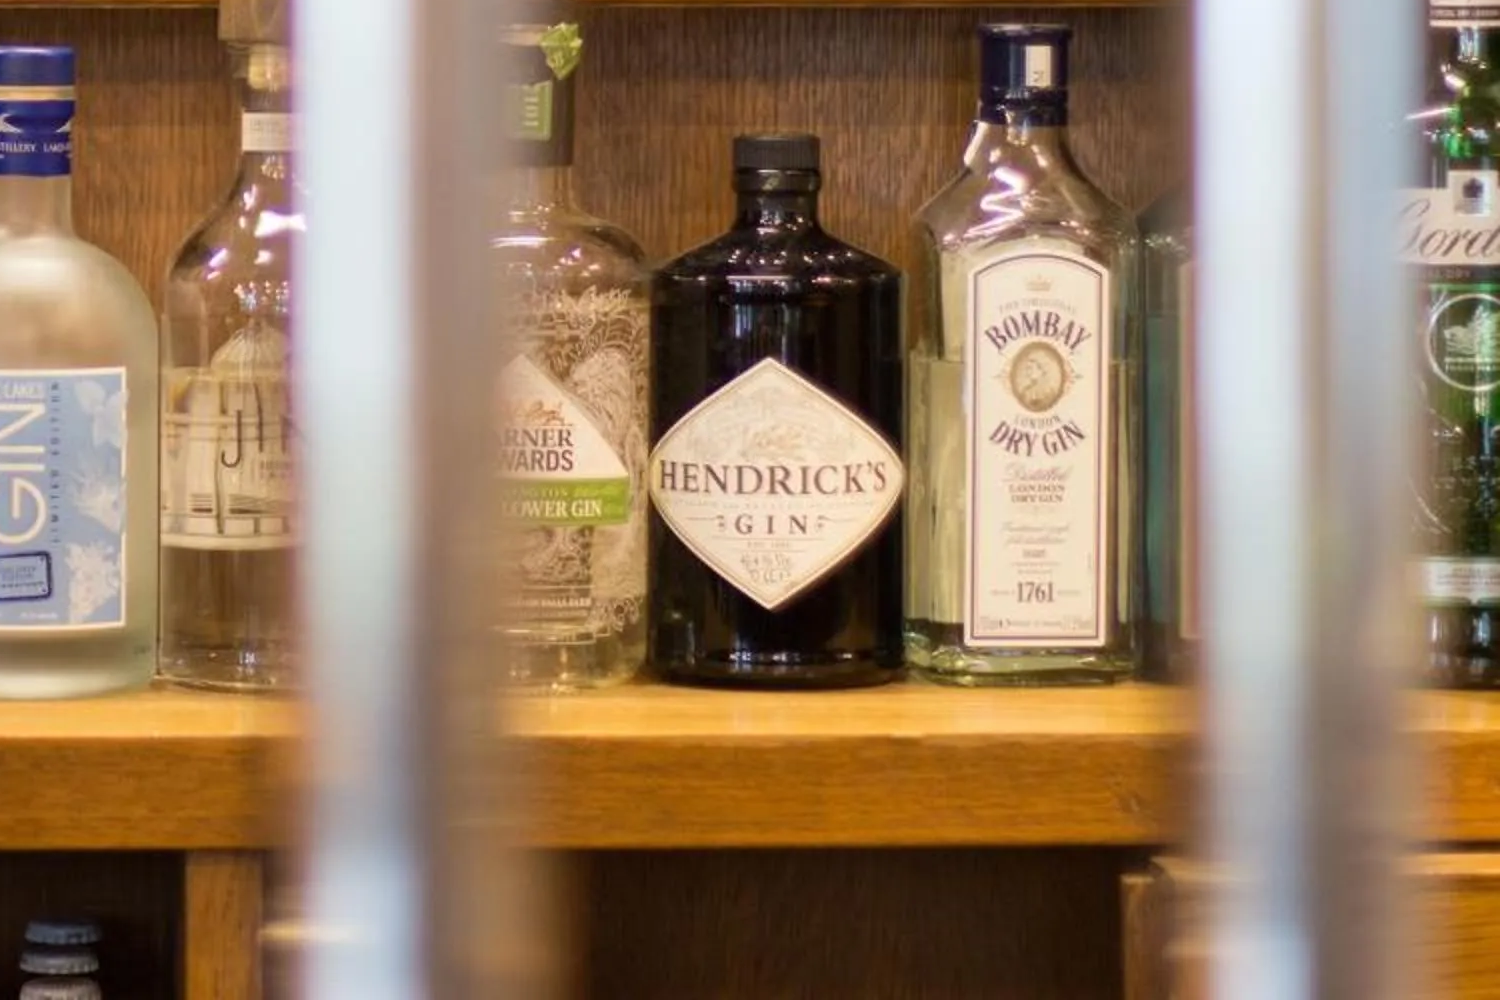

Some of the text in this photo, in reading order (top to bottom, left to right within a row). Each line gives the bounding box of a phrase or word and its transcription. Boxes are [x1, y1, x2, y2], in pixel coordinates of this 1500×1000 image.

[984, 310, 1092, 350] BOMBAY
[989, 419, 1086, 458] DRY GIN
[659, 459, 887, 495] HENDRICK'S
[1008, 483, 1065, 493] LONDON
[571, 499, 603, 518] GIN
[734, 513, 808, 535] GIN
[1017, 581, 1056, 603] 1761
